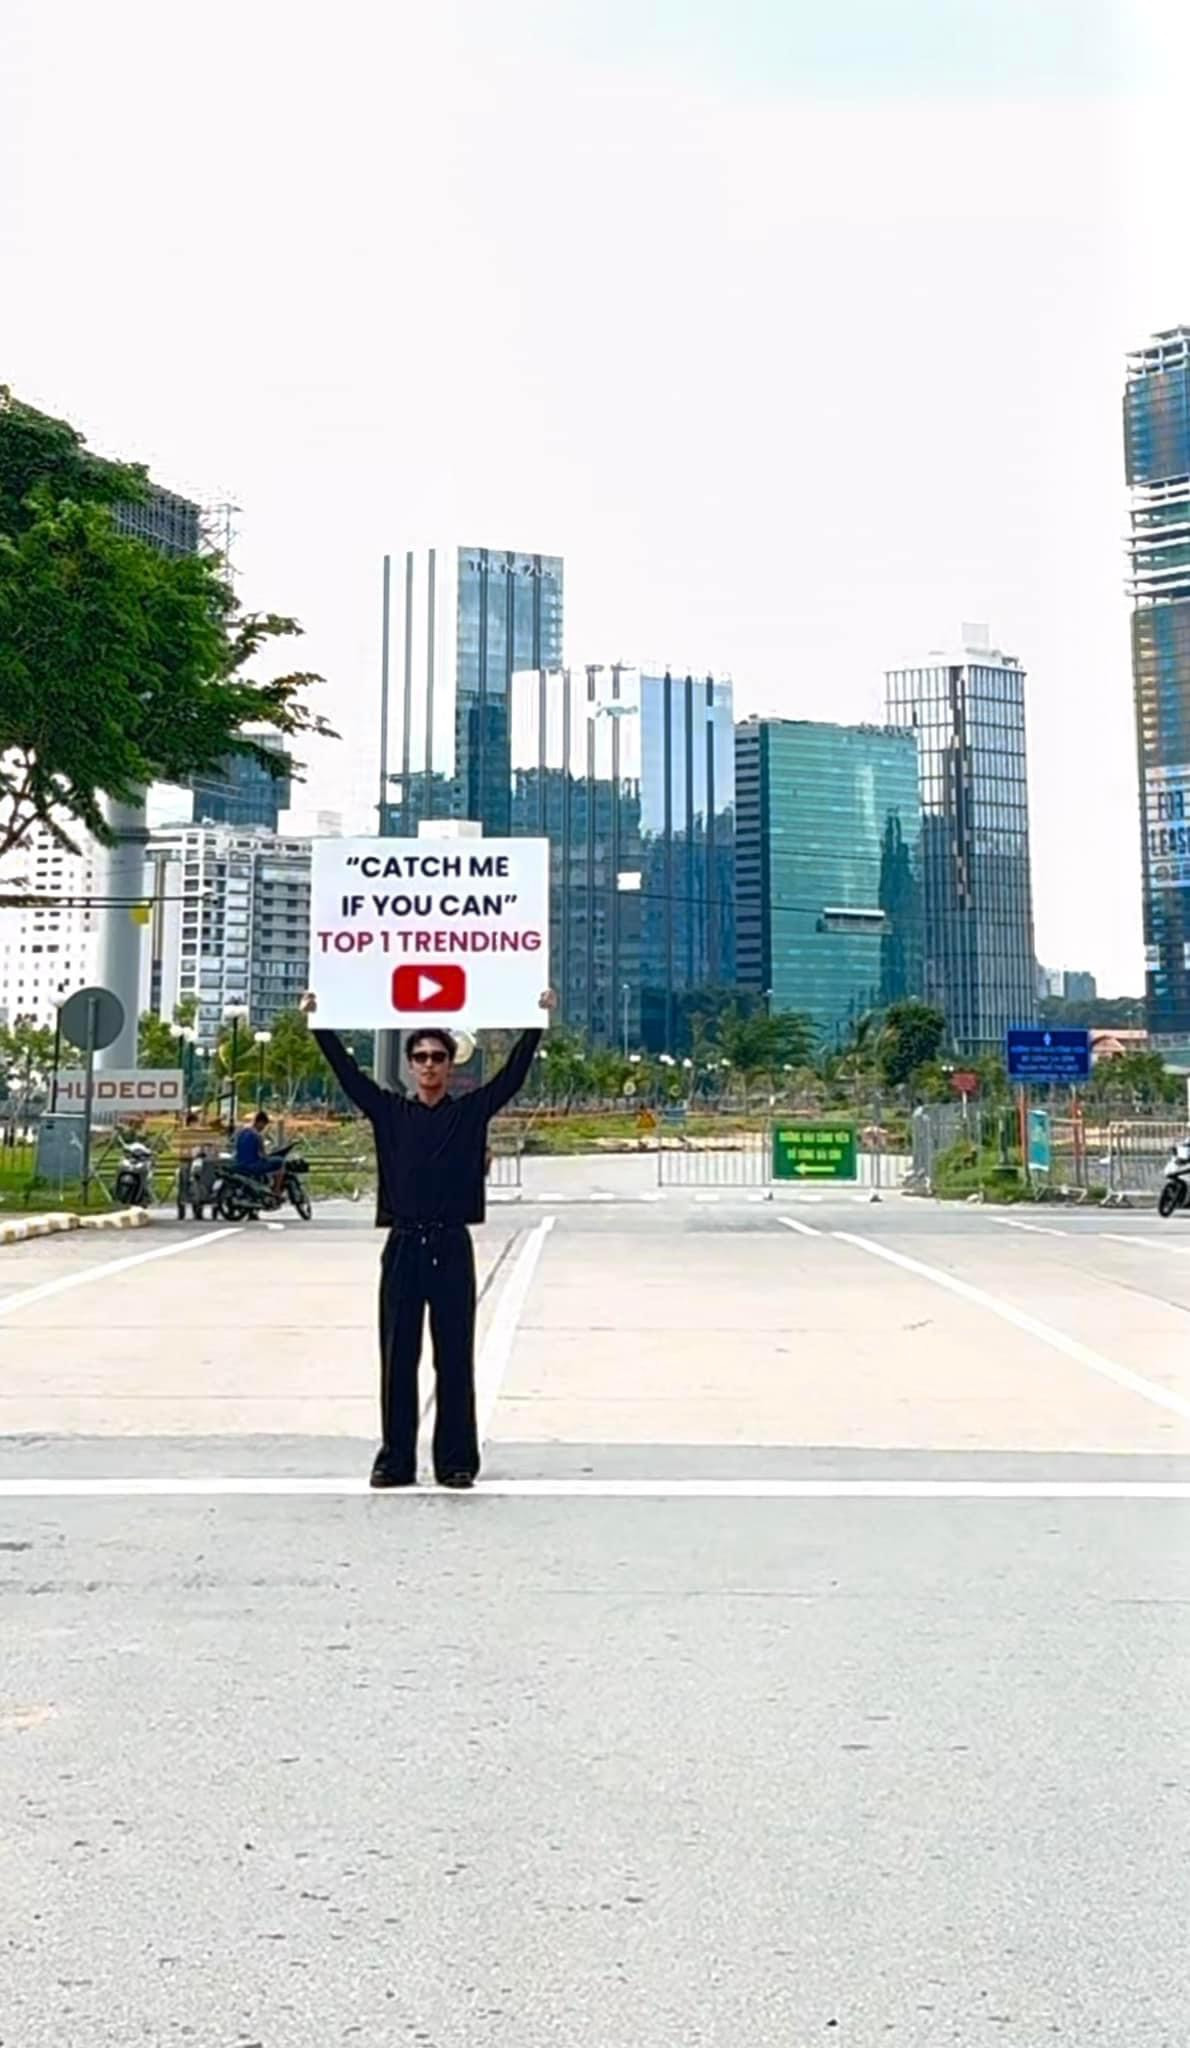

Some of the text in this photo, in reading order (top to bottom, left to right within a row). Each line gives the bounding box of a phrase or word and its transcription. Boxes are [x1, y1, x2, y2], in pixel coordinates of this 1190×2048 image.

[1158, 791, 1184, 821] FOR
[469, 856, 509, 878] ME
[341, 895, 365, 917] IF
[372, 895, 432, 917] YOU
[317, 931, 542, 953] TOP 1 TRENDING
[53, 1081, 179, 1099] HUDECO
